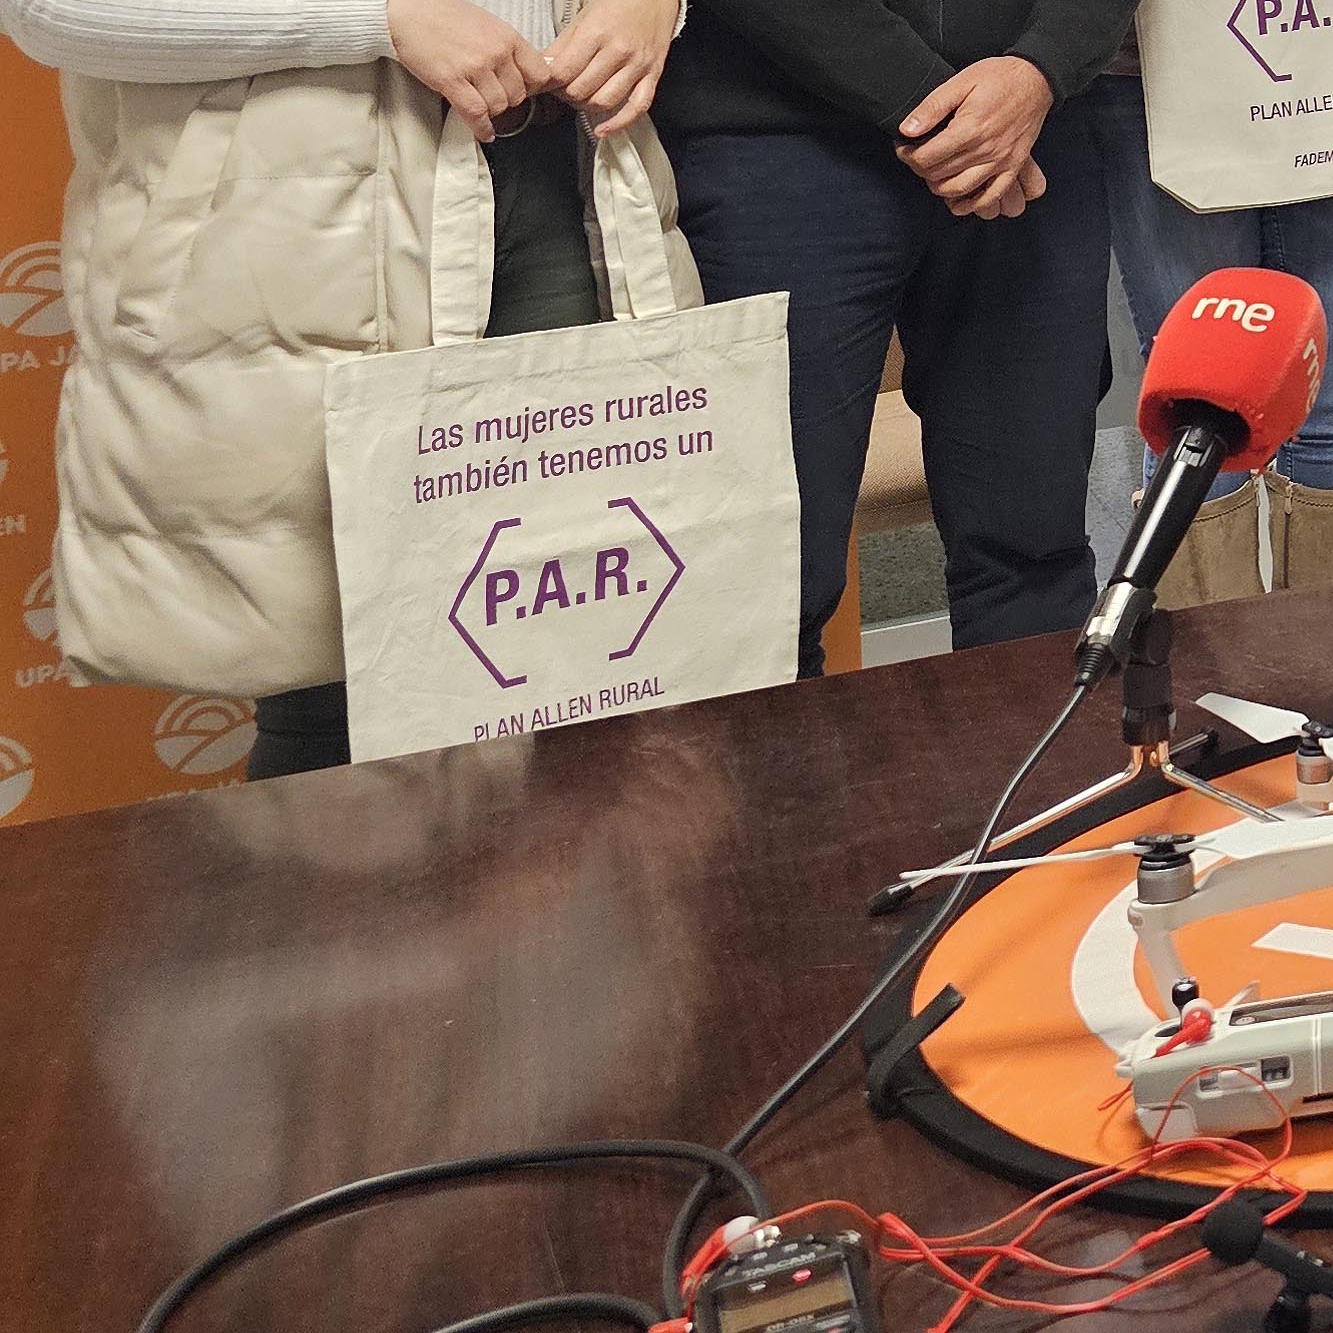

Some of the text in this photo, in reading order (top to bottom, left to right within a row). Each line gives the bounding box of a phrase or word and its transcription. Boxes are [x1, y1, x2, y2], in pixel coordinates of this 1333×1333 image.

[1250, 100, 1292, 121] PLAN
[1192, 297, 1275, 332] rne
[417, 385, 708, 455] Las mujeres rurales
[414, 427, 713, 503] también tenemos un
[486, 546, 648, 626] P.A.R.
[531, 693, 592, 730] ALLEN
[599, 676, 665, 710] RURAL
